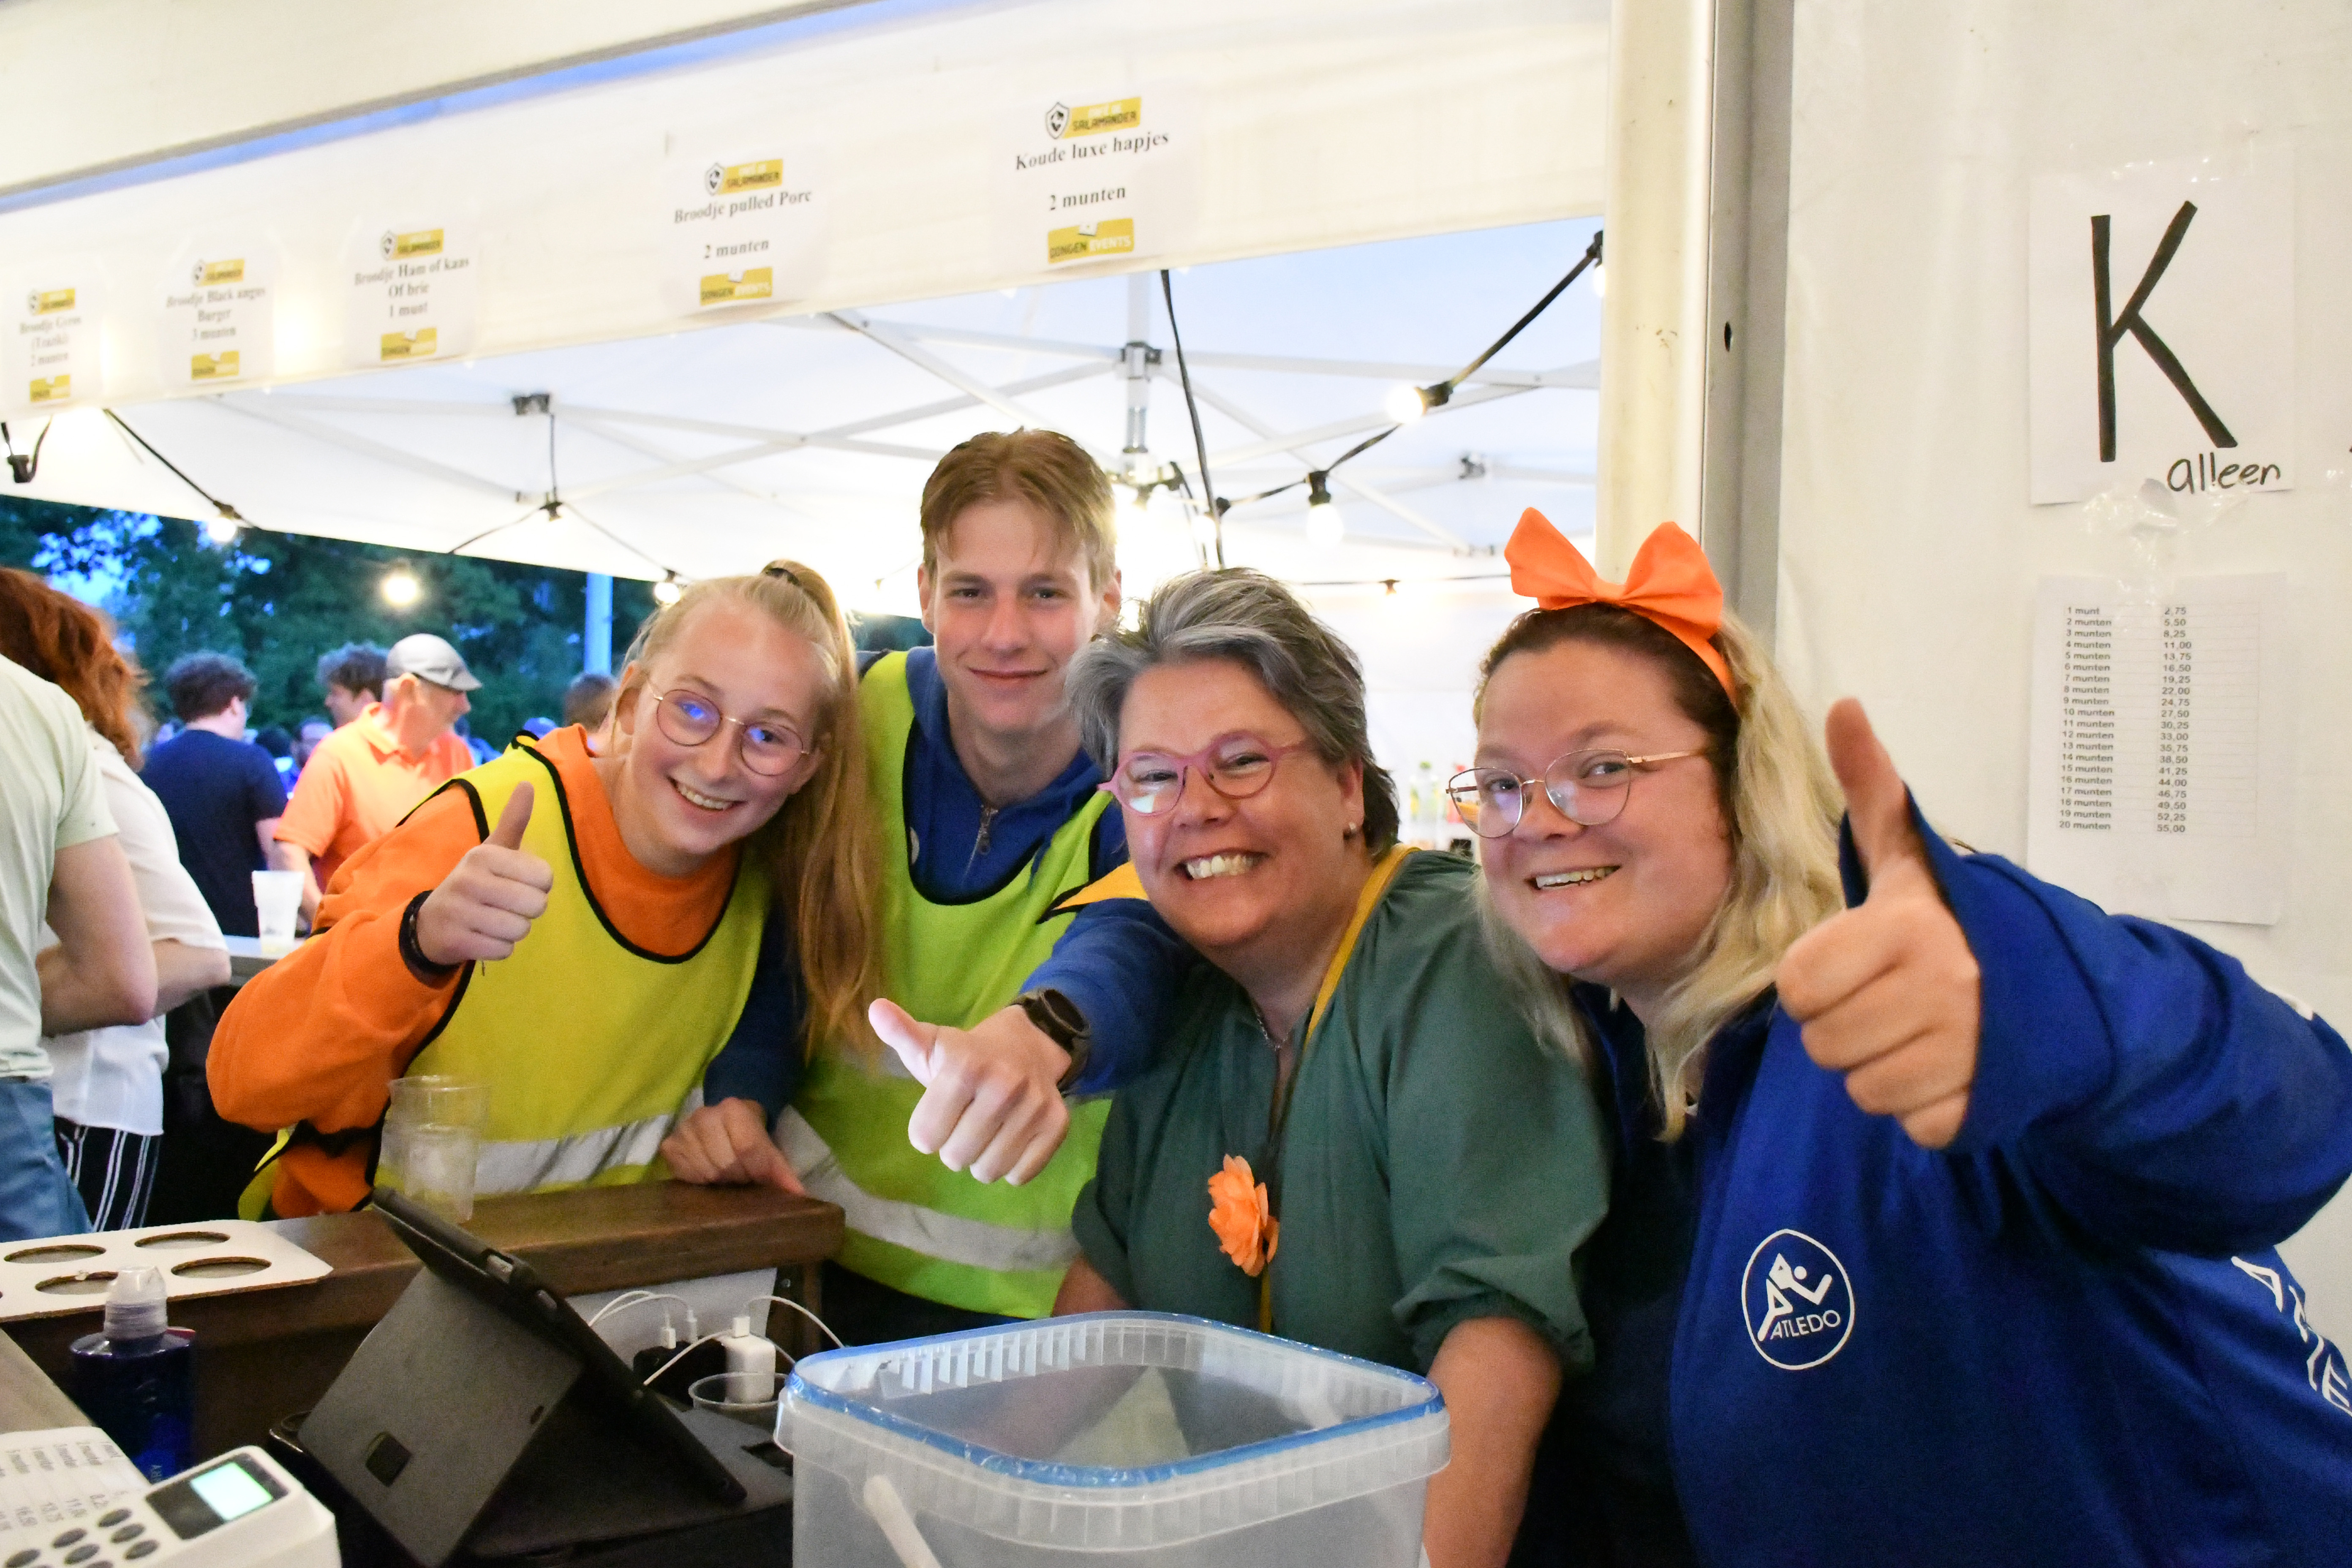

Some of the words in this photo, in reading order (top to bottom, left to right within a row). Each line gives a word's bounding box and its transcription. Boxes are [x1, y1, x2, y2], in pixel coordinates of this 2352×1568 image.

[1016, 147, 1065, 170] Koude
[1073, 144, 1107, 158] luxe
[1113, 132, 1168, 152] hapjes
[1050, 194, 1056, 210] 2
[1063, 187, 1126, 207] munten
[675, 202, 724, 223] Broodje
[730, 194, 774, 217] pulled
[716, 240, 769, 257] munten
[2091, 200, 2238, 462] K
[2167, 451, 2281, 494] alleen
[2075, 607, 2100, 615] munt
[2164, 607, 2186, 615] 2,75
[2067, 618, 2072, 626] 2
[2164, 618, 2186, 626] 5,50
[2163, 630, 2186, 638] 8,25
[2164, 641, 2192, 649] 11,00
[2065, 651, 2071, 659] 5
[2164, 652, 2191, 661] 13,75
[2164, 664, 2191, 672] 16,50
[2163, 675, 2191, 684] 19,25
[2063, 685, 2070, 693] 8
[2162, 686, 2191, 695] 22,00
[2161, 698, 2190, 707] 24,75
[2161, 710, 2190, 718] 27,50
[2161, 721, 2189, 730] 30,25
[2062, 730, 2074, 738] 12
[2161, 732, 2189, 741] 33,00
[2076, 743, 2114, 751] munten
[2160, 744, 2189, 752] 35,75
[2075, 754, 2114, 762] munten
[2160, 755, 2189, 764] 38,50
[2159, 767, 2188, 776] 41,25
[2074, 776, 2112, 784] munten
[2159, 779, 2188, 787] 44,00
[2158, 790, 2187, 798] 46,75
[2074, 799, 2112, 807] munten
[2157, 801, 2186, 810] 49,50
[2073, 811, 2112, 819] munten
[2157, 812, 2186, 822] 52,25
[2059, 820, 2071, 828] 20
[2073, 822, 2111, 830] munten
[2157, 824, 2186, 833] 55,00
[1770, 1309, 1841, 1340] ATLEDO
